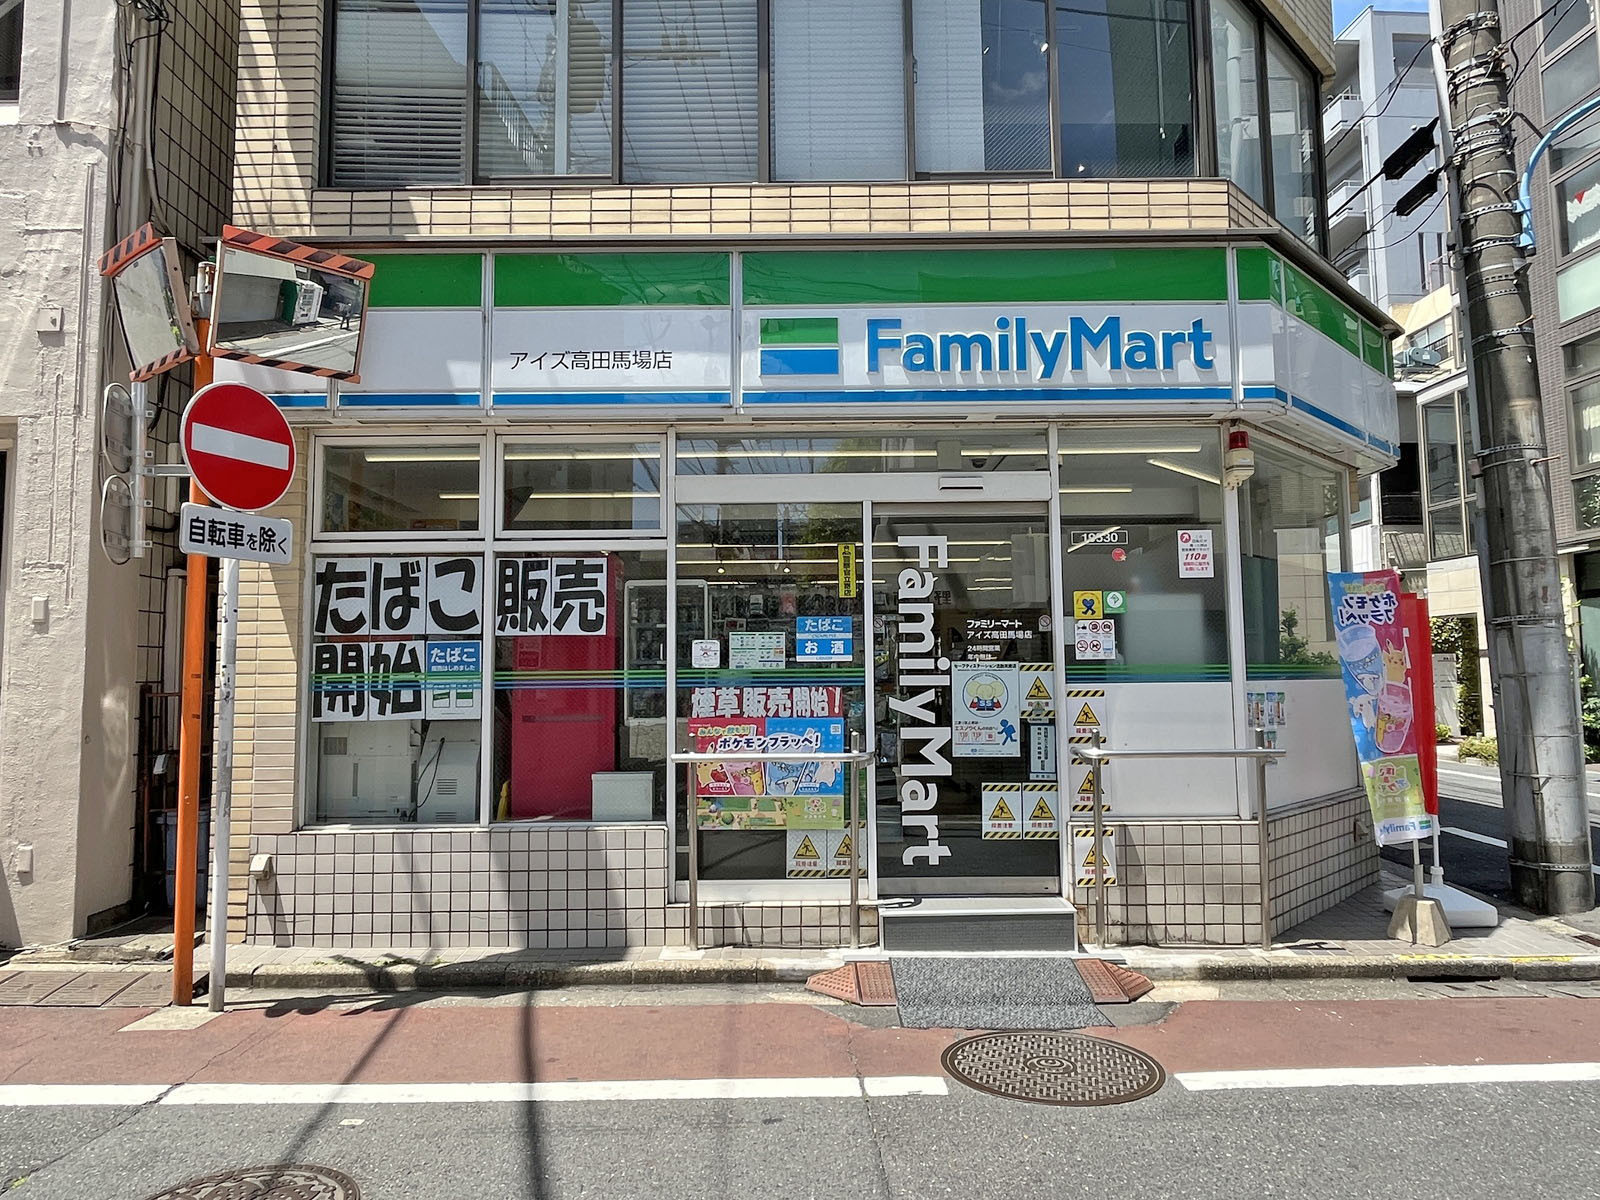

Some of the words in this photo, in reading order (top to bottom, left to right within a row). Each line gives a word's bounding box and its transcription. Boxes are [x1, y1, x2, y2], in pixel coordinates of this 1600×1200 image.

[509, 349, 673, 371] アイズ高田馬場店
[865, 315, 1214, 380] FamilyMart
[189, 516, 288, 555] 自転車を除く
[315, 558, 480, 634] たばこ
[497, 559, 605, 632] 販売
[804, 618, 844, 632] たばこ
[966, 619, 1023, 629] ファミリーマート
[966, 630, 1033, 640] アイズ高田馬場店
[430, 647, 476, 664] たばこ
[804, 640, 845, 655] お酒
[312, 643, 422, 718] 開始
[691, 686, 842, 719] 煙草販売開始!
[888, 535, 953, 866] FamilyMart
